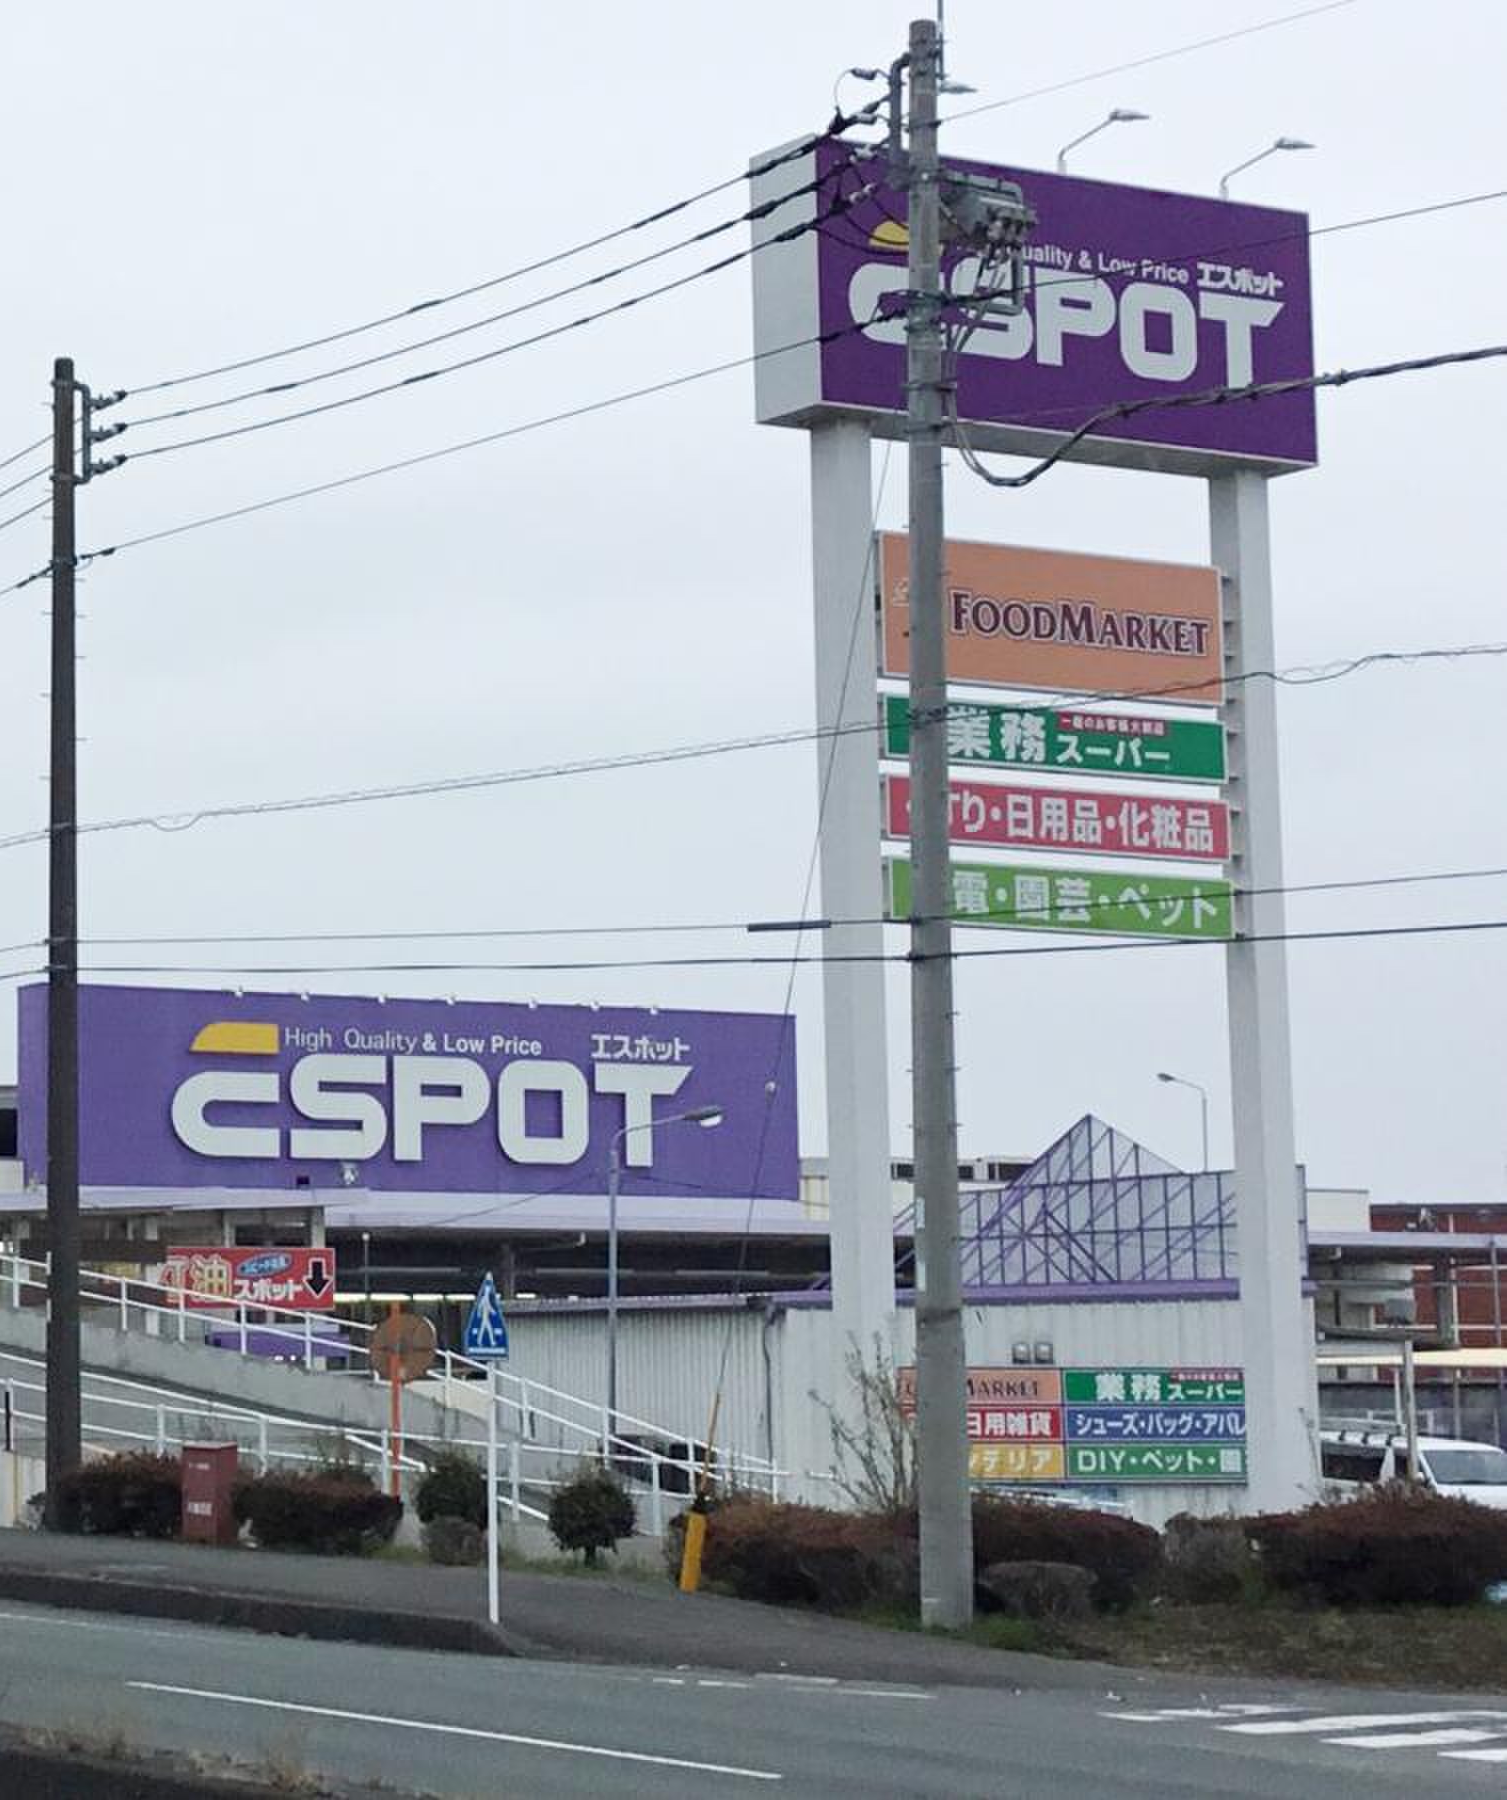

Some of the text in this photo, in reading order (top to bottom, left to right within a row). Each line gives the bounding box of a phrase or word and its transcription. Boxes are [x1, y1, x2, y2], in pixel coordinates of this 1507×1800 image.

[1012, 244, 1189, 283] uality & Low Price
[1196, 262, 1285, 296] エスポット
[946, 788, 1214, 853] り・日用品・化粧品
[284, 1027, 542, 1057] High Quality & Low Price
[591, 1034, 690, 1062] エスポット
[234, 1279, 303, 1301] スポット
